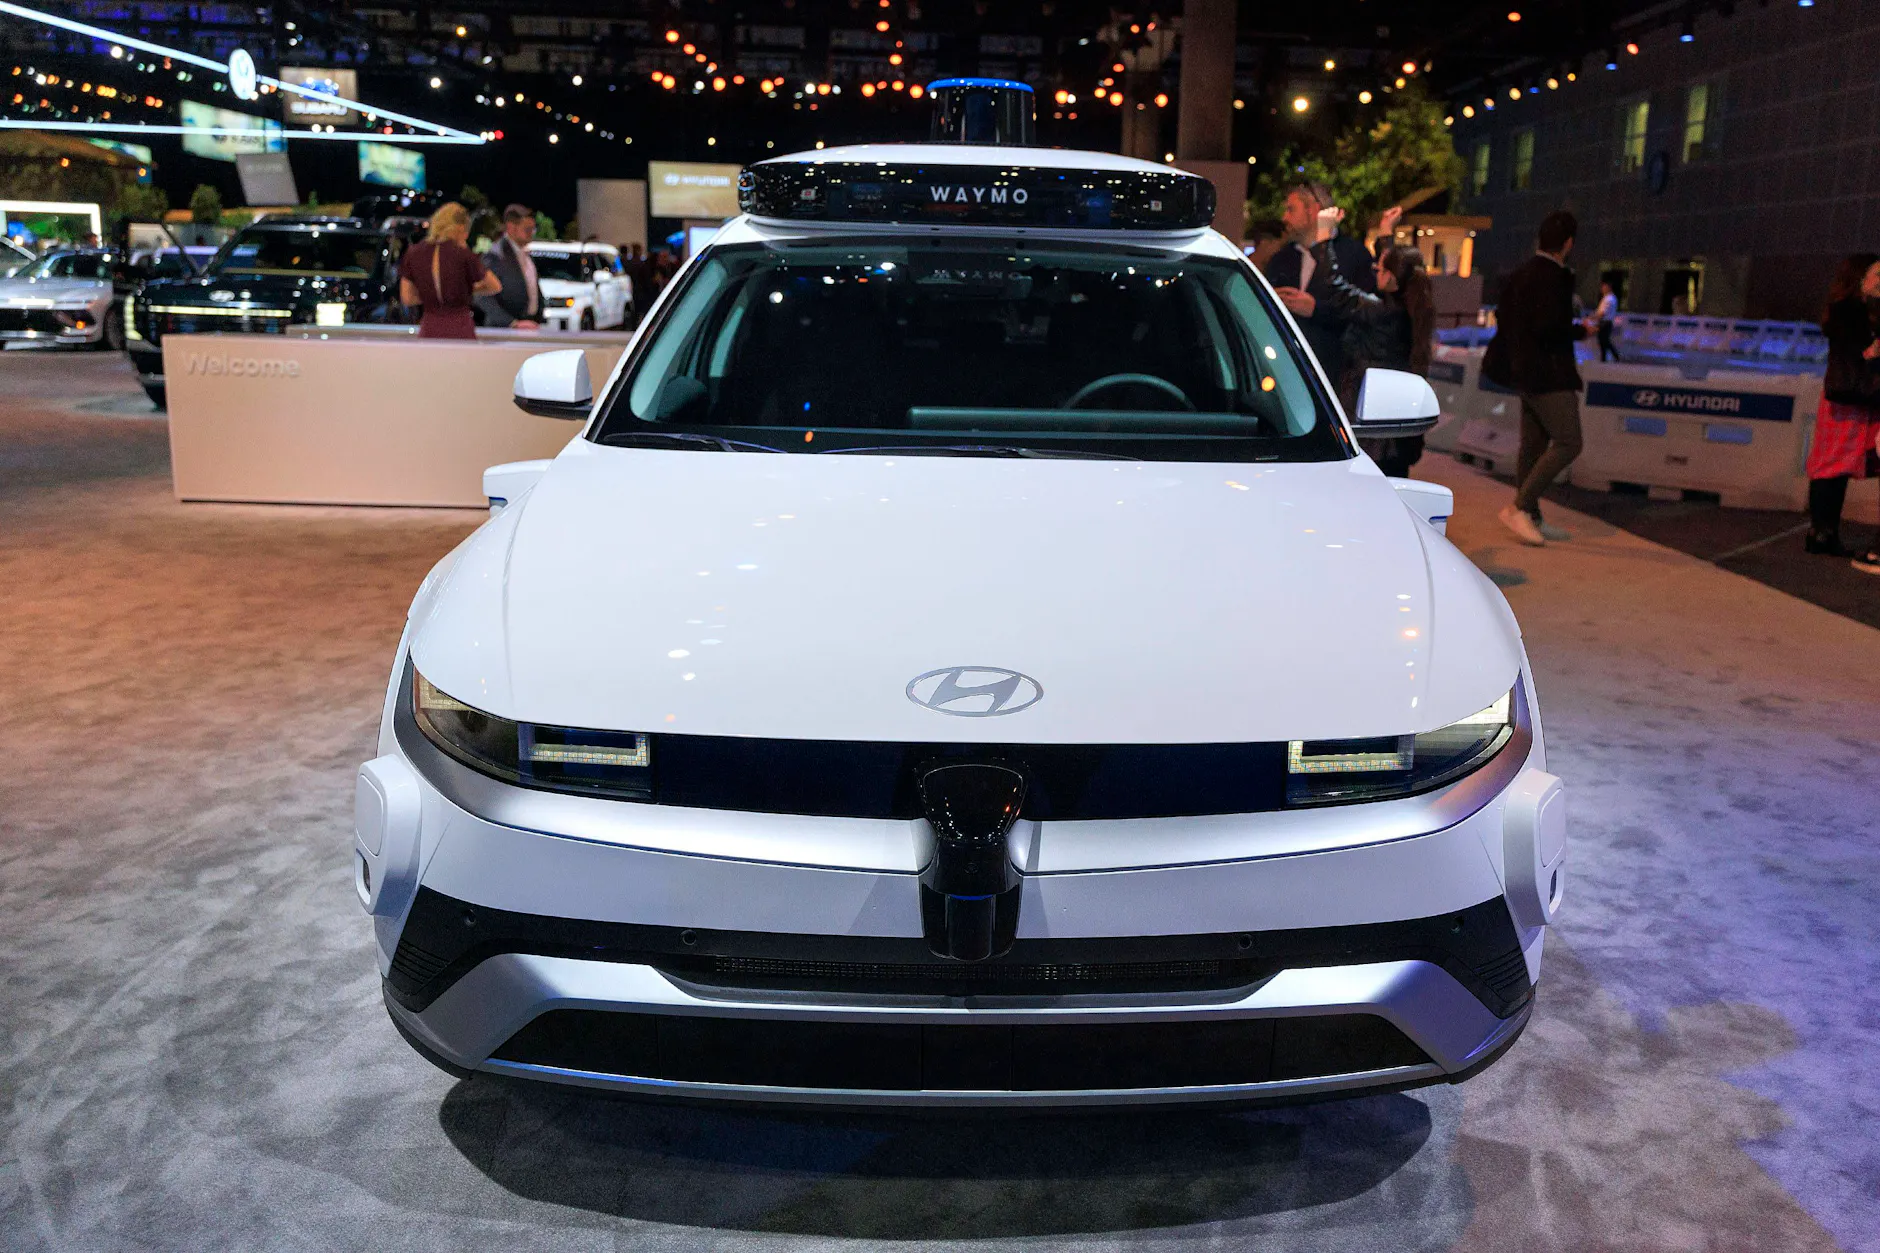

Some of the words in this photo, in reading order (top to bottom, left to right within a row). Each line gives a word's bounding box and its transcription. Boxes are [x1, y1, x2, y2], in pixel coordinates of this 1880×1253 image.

[930, 185, 1028, 204] WAYMO
[182, 350, 300, 378] Welcome
[1663, 392, 1740, 412] HYUNDAI
